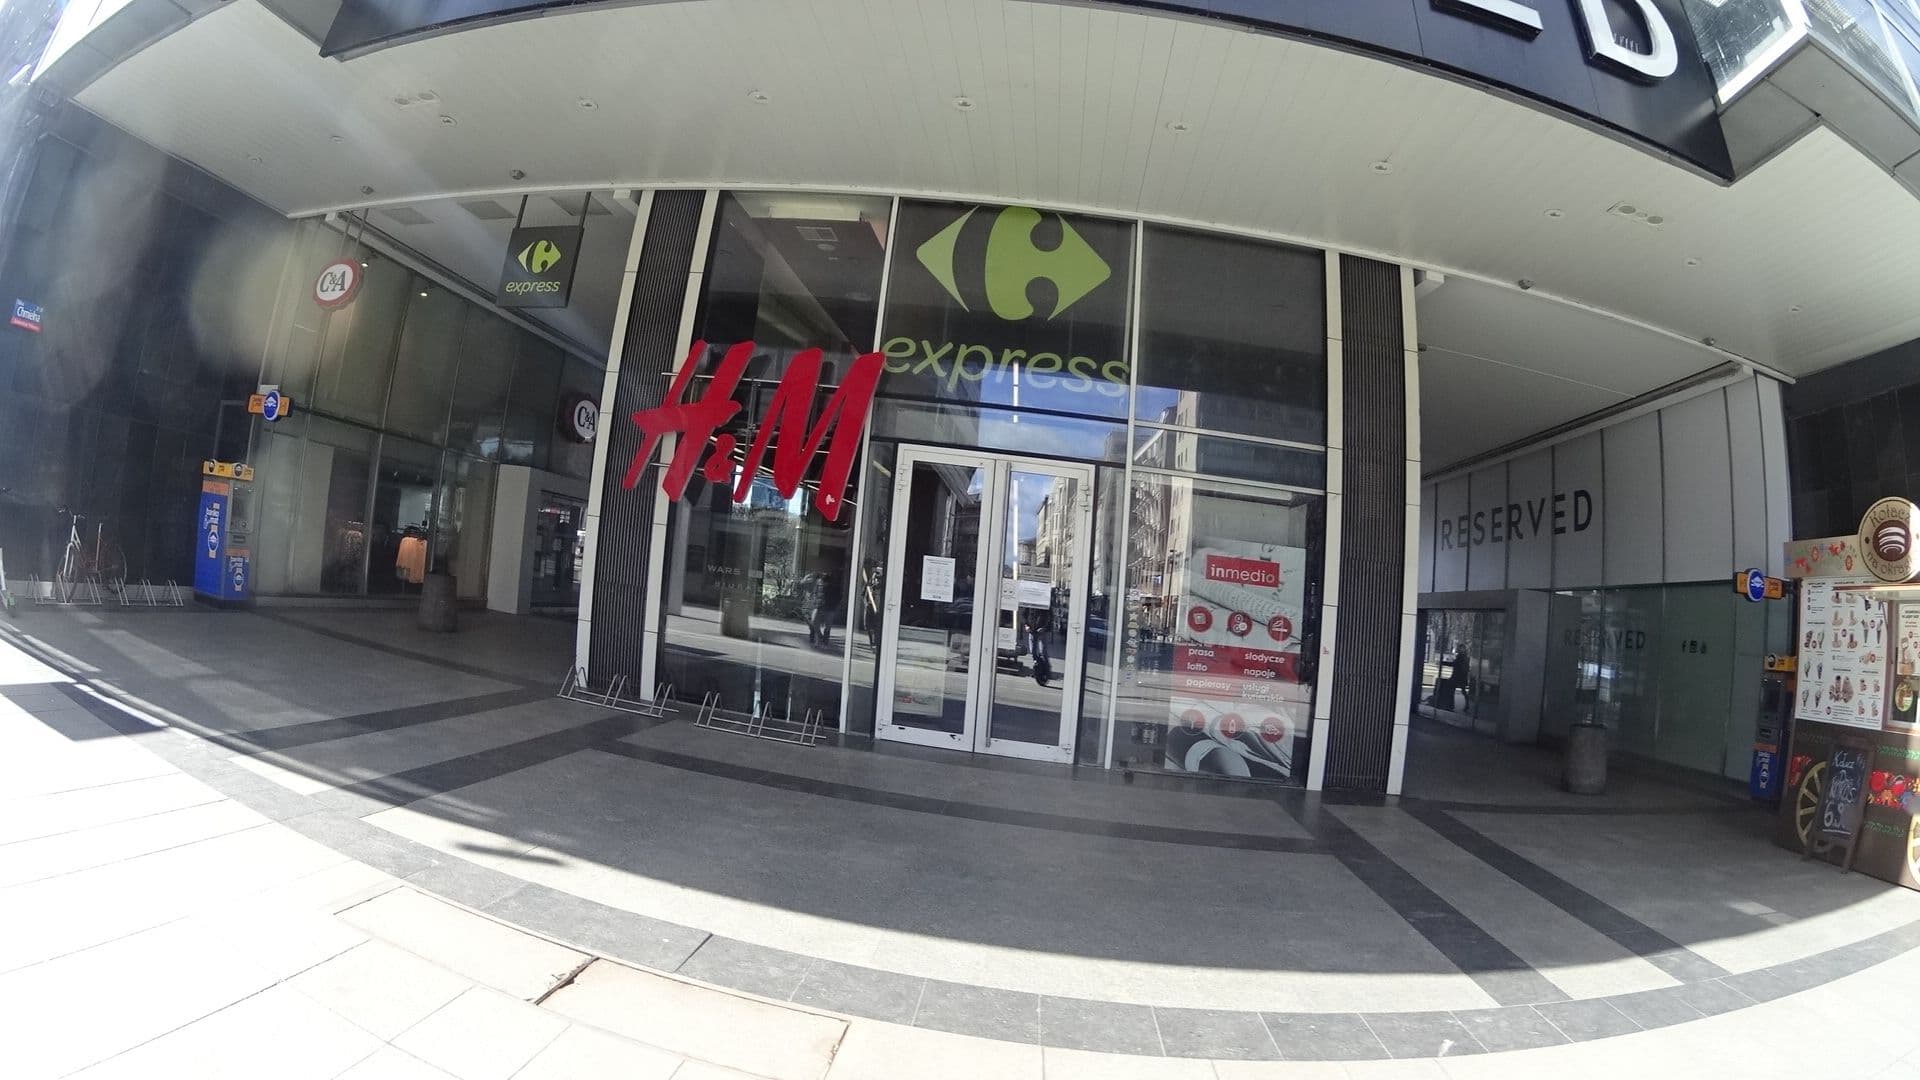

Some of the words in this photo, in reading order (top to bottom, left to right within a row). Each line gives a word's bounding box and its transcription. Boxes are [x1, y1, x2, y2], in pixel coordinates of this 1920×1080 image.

[318, 271, 346, 294] C&A
[505, 280, 561, 296] express
[883, 336, 1132, 398] express
[576, 405, 596, 431] C&A
[622, 339, 886, 522] H&M
[1440, 488, 1594, 551] RESERVED
[1210, 563, 1275, 584] inmedio
[1188, 648, 1214, 657] prasa
[1187, 662, 1208, 672] lotto
[1243, 668, 1277, 679] napoje
[1186, 678, 1232, 691] papierosy
